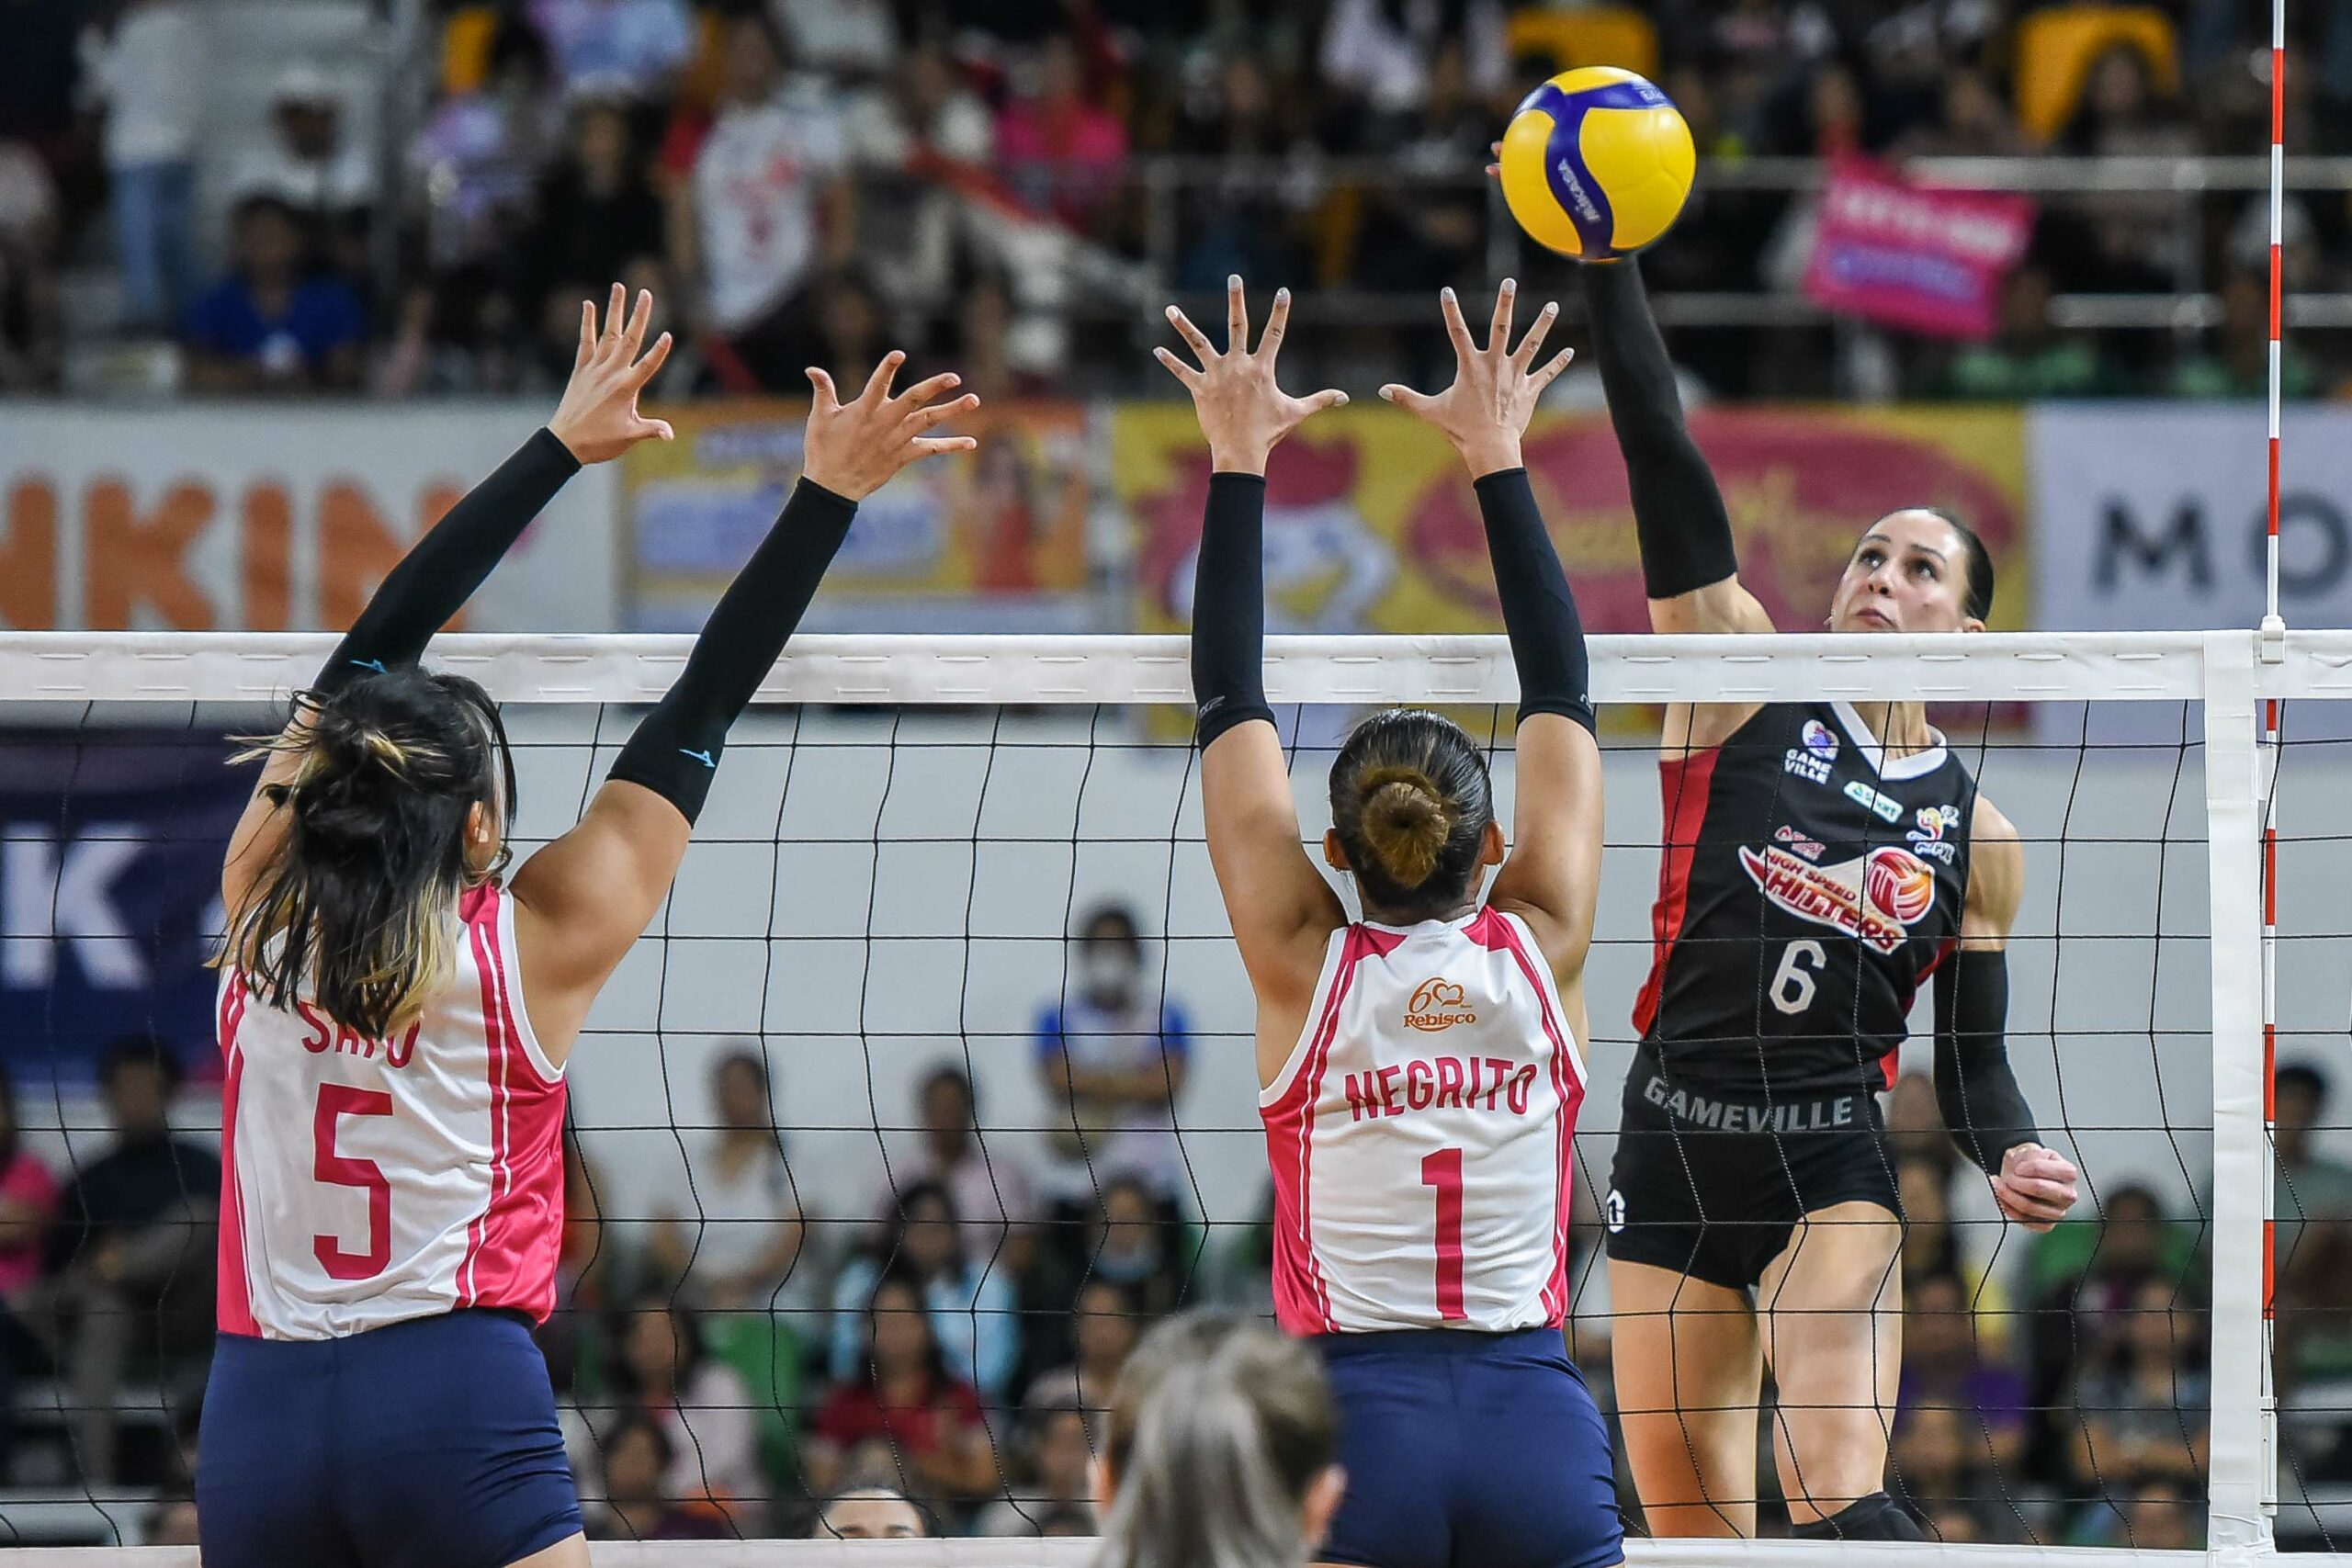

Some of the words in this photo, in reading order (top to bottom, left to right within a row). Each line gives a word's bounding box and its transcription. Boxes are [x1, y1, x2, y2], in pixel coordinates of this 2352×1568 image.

[1784, 758, 1829, 785] VILLE
[1785, 748, 1833, 774] GAME
[1766, 850, 1804, 875] HIGH
[1806, 869, 1857, 902] SPEED
[1766, 871, 1901, 950] HITTERS
[1769, 940, 1827, 1016] 6
[1403, 1012, 1477, 1028] Rebisco
[1344, 1056, 1538, 1122] NEGRITO
[1643, 1076, 1853, 1134] GAMEVILLE
[313, 1082, 393, 1280] 5
[1420, 1147, 1468, 1321] 1
